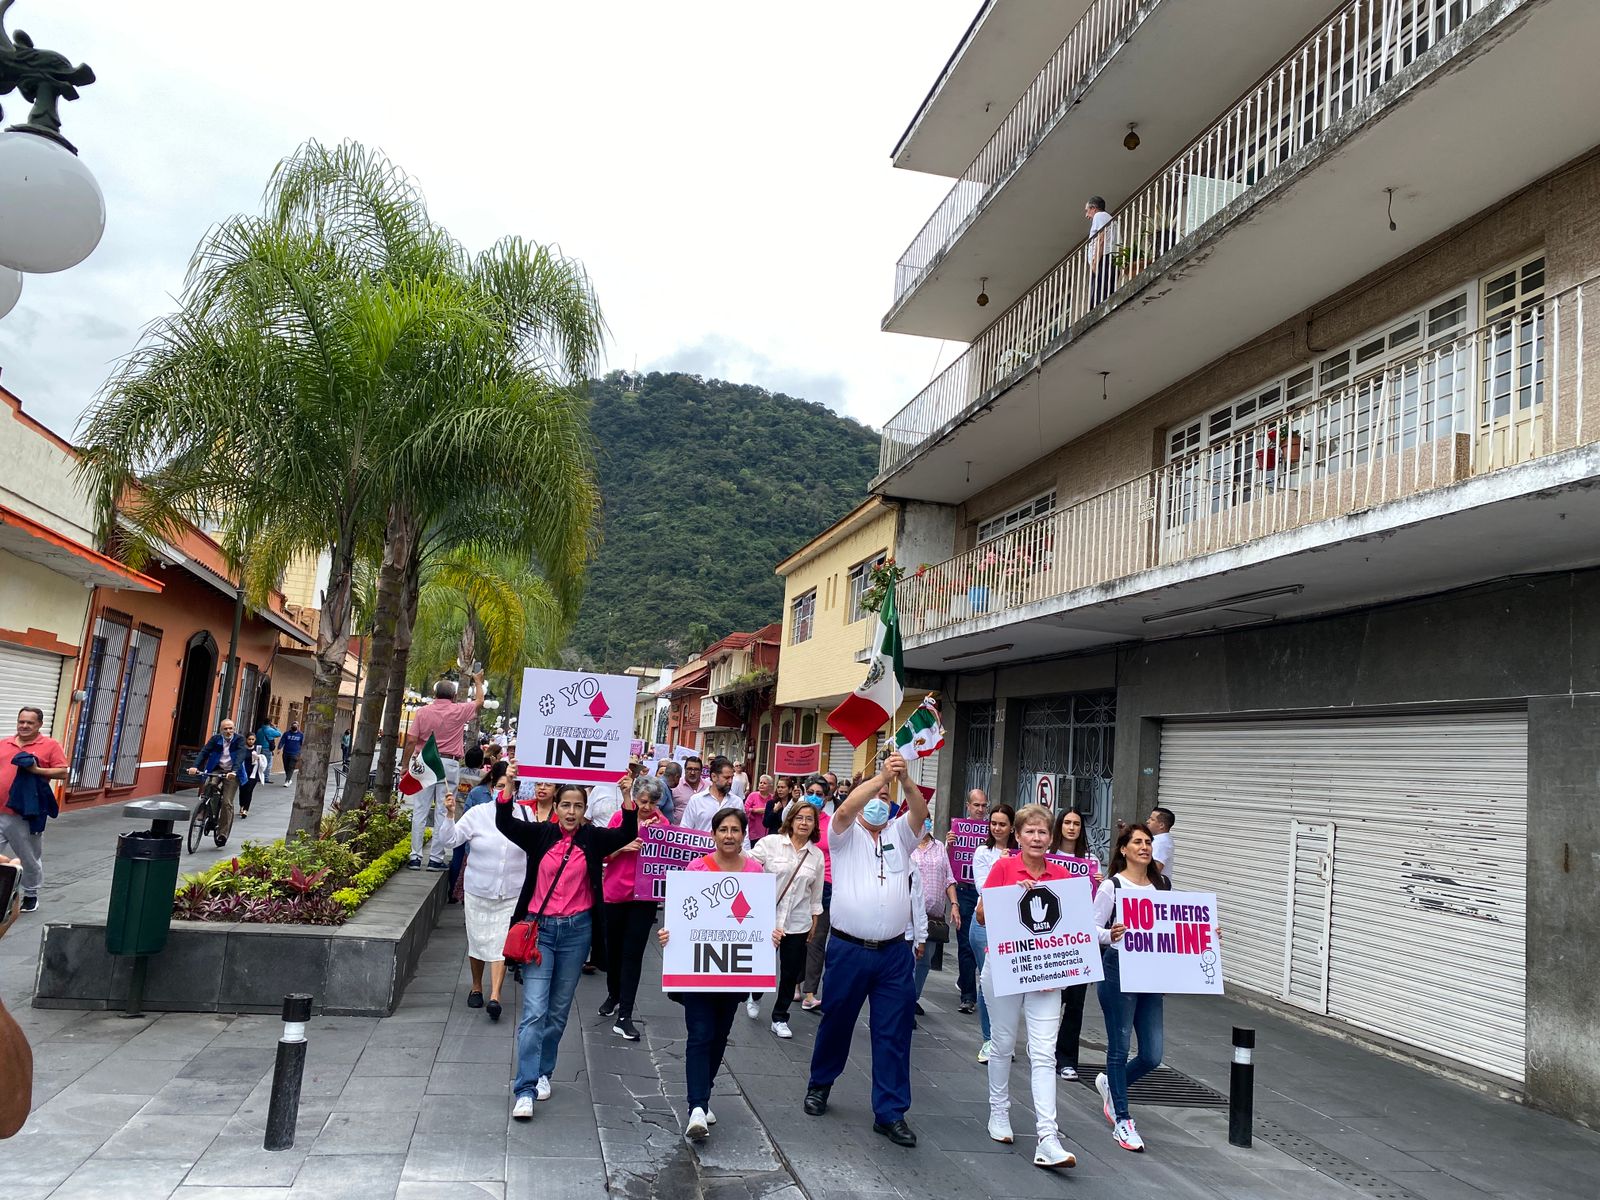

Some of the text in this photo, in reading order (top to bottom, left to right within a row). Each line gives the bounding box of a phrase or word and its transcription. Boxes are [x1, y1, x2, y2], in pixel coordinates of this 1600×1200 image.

[544, 725, 620, 740] DEFIENDO AL
[545, 738, 608, 768] INE
[958, 823, 971, 833] YO
[648, 828, 716, 849] YO DEFIEND
[953, 836, 967, 847] MI
[641, 843, 658, 857] MI
[1122, 898, 1210, 930] NO TE METAS
[1033, 921, 1051, 931] BASTA
[690, 929, 764, 942] DEFIENDO AL
[1124, 931, 1154, 952] CON
[693, 943, 753, 973] INE
[1011, 957, 1018, 965] el
[1020, 955, 1031, 963] INE
[1053, 948, 1079, 959] negocia
[1012, 965, 1019, 973] el
[1020, 963, 1032, 972] INE
[1044, 957, 1083, 968] democracia
